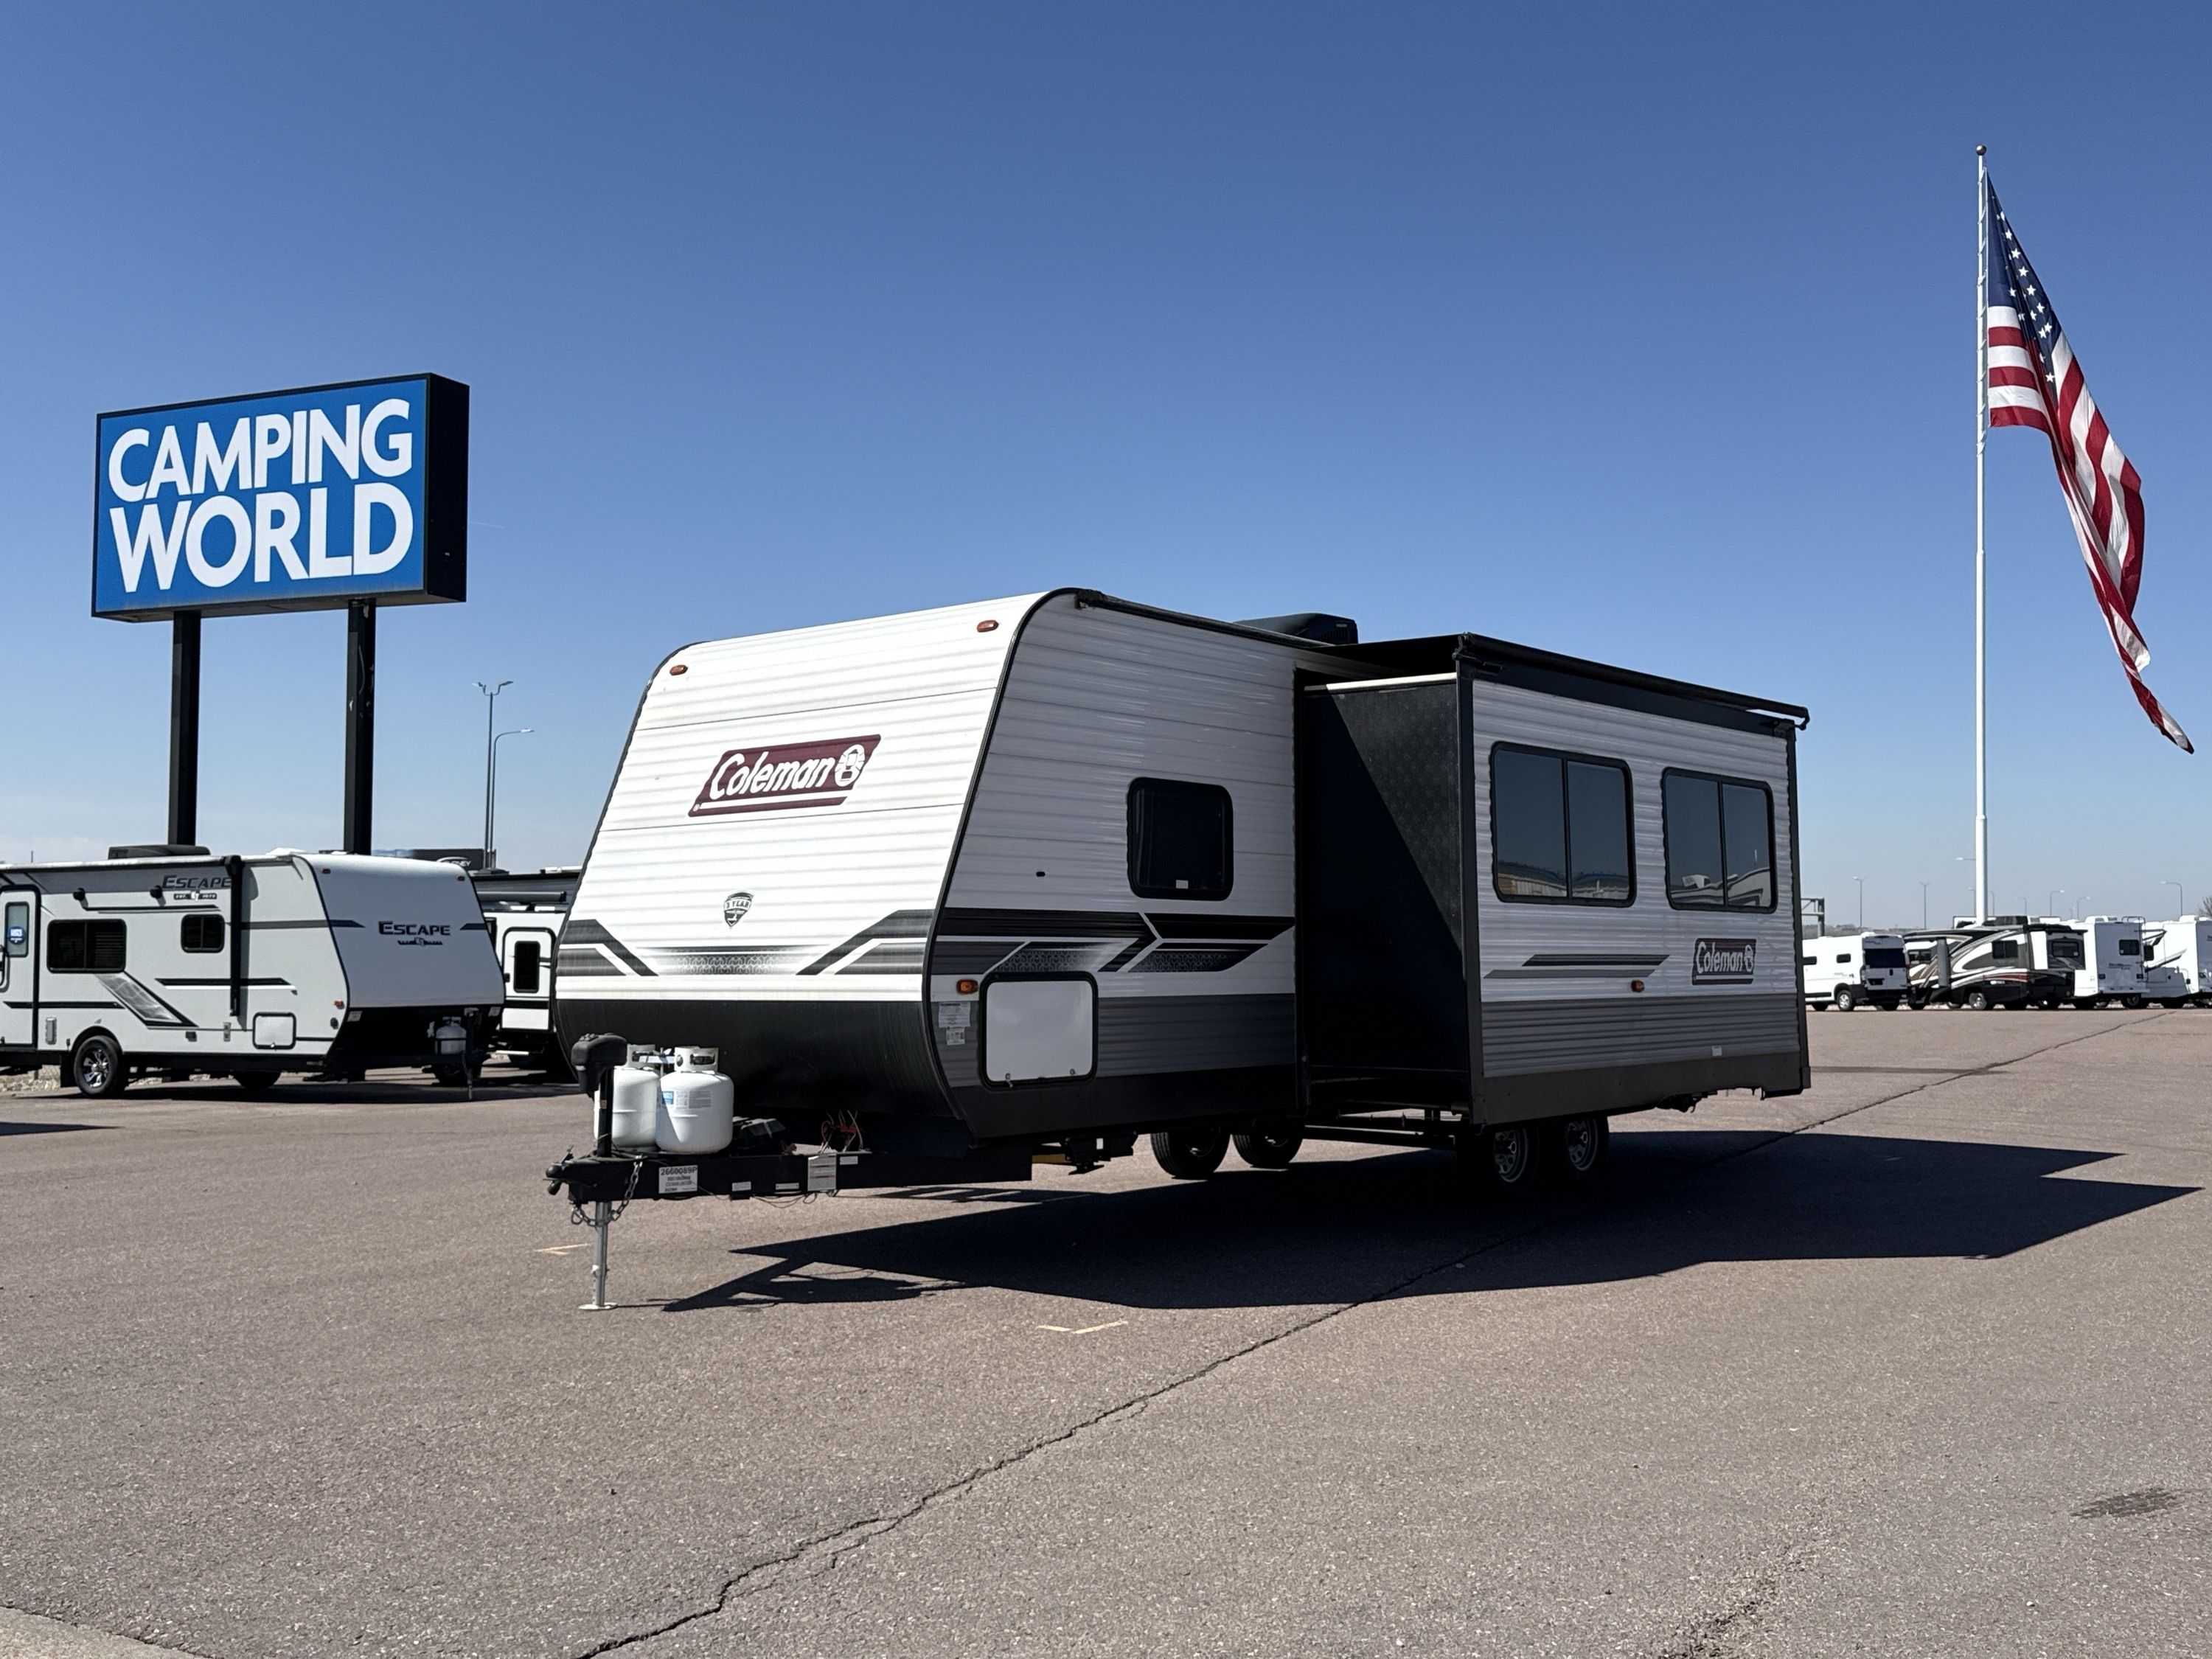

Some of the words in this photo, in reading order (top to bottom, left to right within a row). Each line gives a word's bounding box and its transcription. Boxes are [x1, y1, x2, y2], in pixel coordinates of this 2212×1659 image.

[108, 398, 412, 502] CAMPING
[109, 482, 414, 593] WORLD
[709, 751, 835, 800] Coleman
[162, 874, 232, 889] ESCAPE
[378, 921, 451, 936] ESCAPE
[1697, 941, 1743, 974] Coleman
